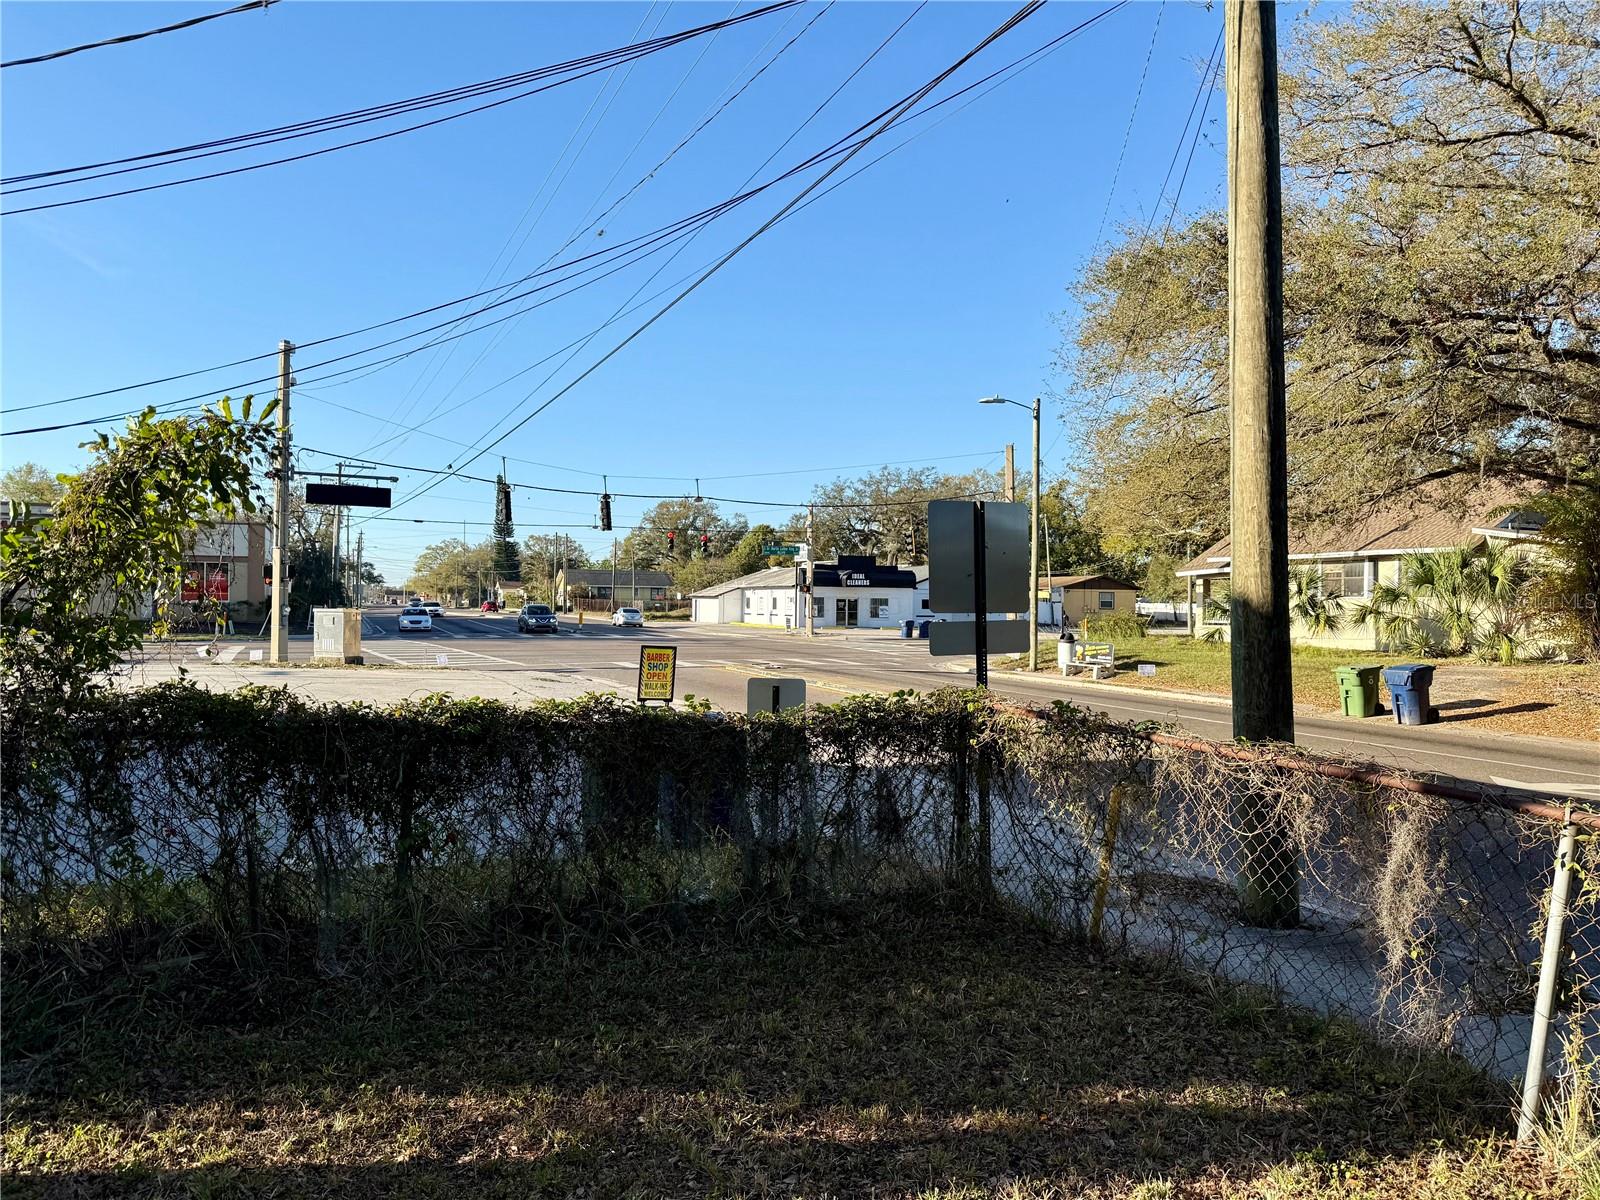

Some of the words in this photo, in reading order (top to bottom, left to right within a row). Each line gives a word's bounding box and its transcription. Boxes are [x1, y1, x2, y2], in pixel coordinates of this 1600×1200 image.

[646, 653, 670, 662] BARBER
[647, 662, 669, 671] SHOP
[646, 672, 668, 680] OPEN
[644, 682, 668, 690] WALK-INS
[644, 690, 668, 698] WELCOME
